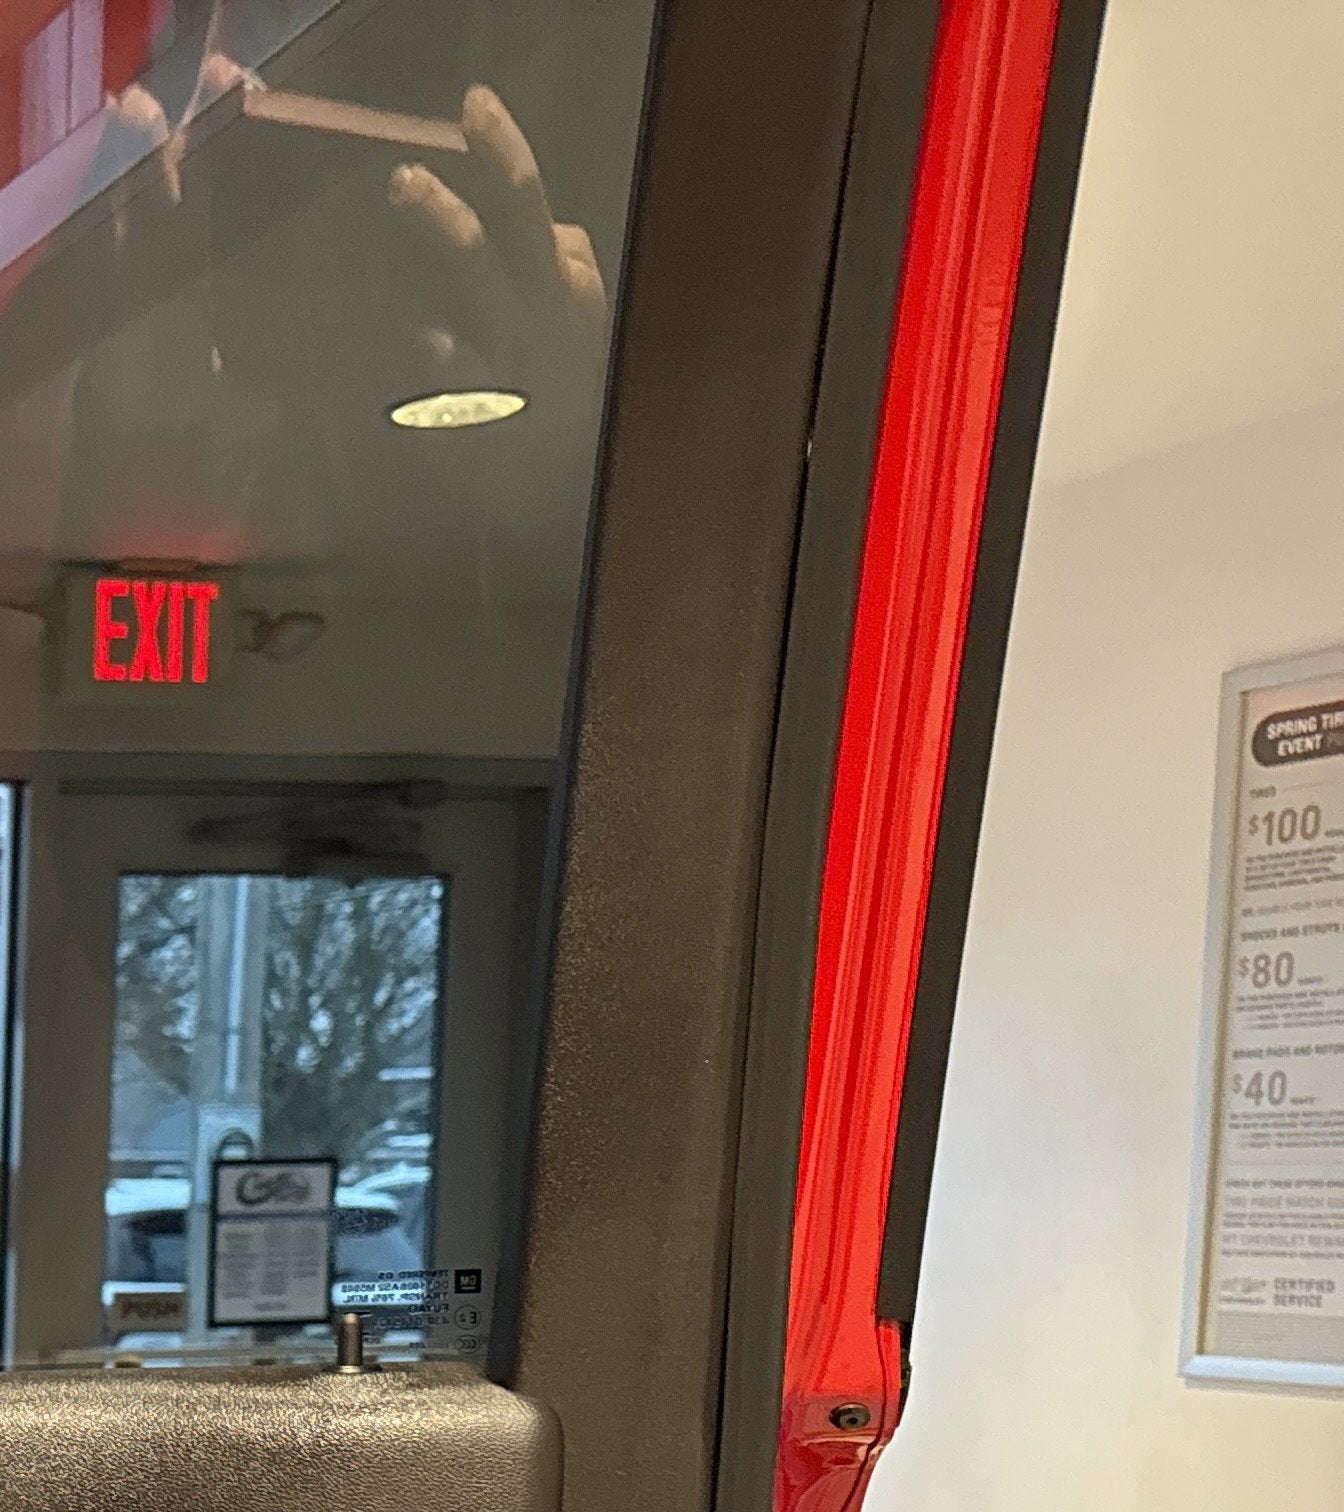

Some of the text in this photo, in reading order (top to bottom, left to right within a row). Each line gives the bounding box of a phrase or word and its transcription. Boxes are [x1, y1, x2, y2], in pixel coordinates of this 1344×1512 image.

[93, 578, 220, 683] EXIT
[1267, 716, 1318, 740] SPRING
[1277, 732, 1323, 757] EVENT
[1248, 804, 1321, 846] $100
[1238, 951, 1295, 990] $80
[1233, 1069, 1287, 1106] $40
